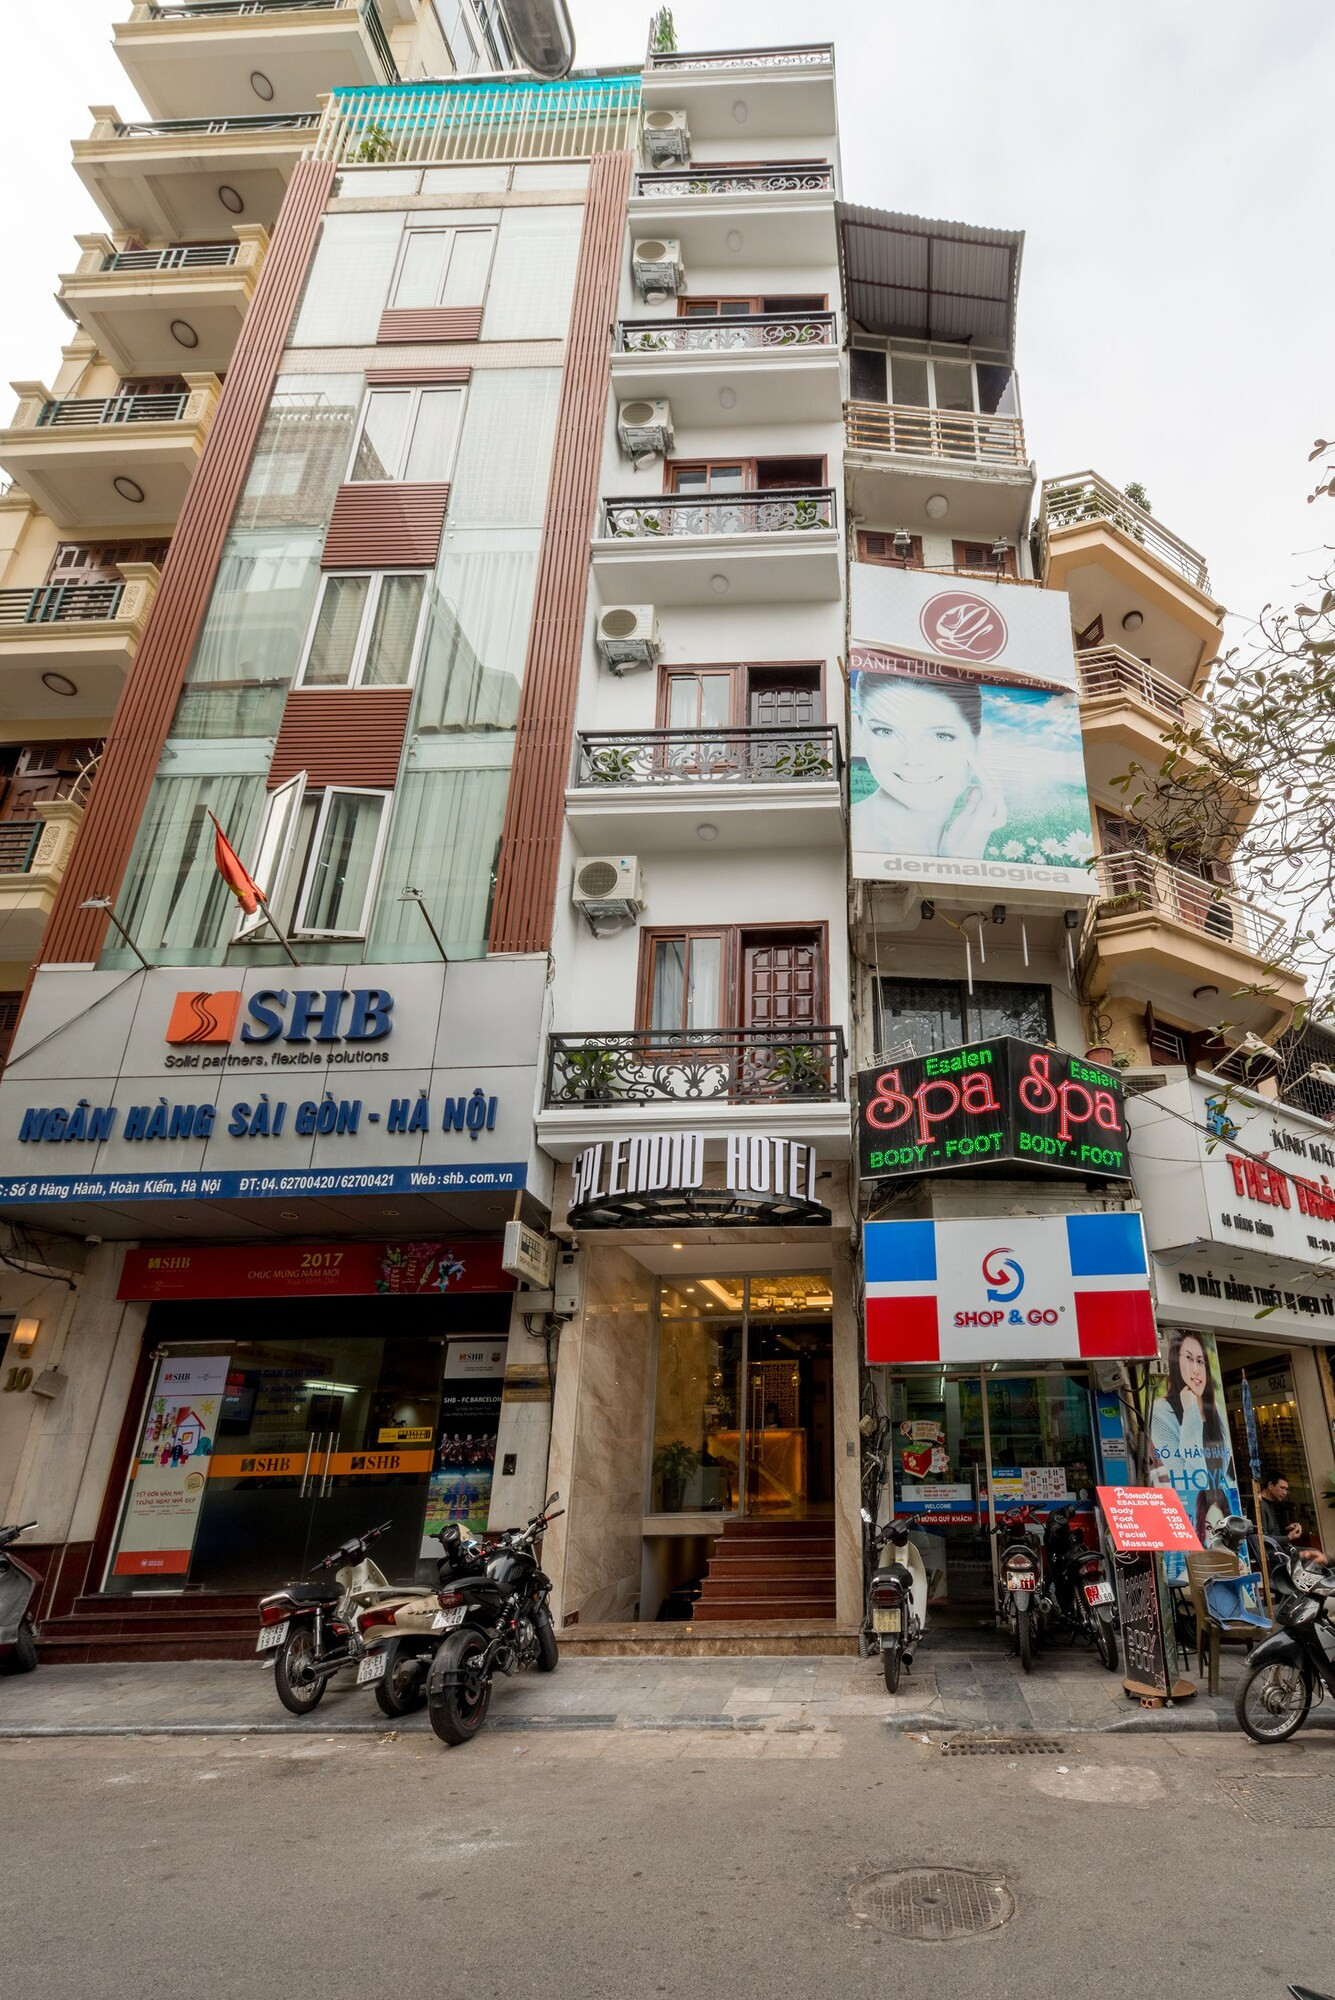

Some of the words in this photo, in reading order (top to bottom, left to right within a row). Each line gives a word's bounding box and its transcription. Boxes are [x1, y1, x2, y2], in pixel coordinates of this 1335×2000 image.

[883, 857, 1070, 884] dermalogica
[241, 989, 394, 1043] SHB
[164, 1050, 200, 1068] Solid
[201, 1052, 268, 1069] partners,
[271, 1051, 322, 1066] flexible
[326, 1049, 390, 1064] solutions
[925, 1049, 993, 1076] Esalen
[866, 1069, 1000, 1145] Spa
[1019, 1054, 1122, 1141] Spa
[17, 1098, 118, 1143] NGÂN
[122, 1097, 218, 1141] HÀNG
[228, 1093, 288, 1137] SÀI
[295, 1091, 362, 1135] GÒN
[387, 1089, 429, 1132] HÀ
[442, 1087, 499, 1139] NỘI
[870, 1145, 926, 1168] BODY
[946, 1133, 1003, 1158] FOOT
[1019, 1132, 1067, 1157] BODY
[1081, 1145, 1122, 1168] FOOT
[568, 1131, 704, 1208] SPLENDID
[727, 1133, 822, 1204] HOTEL
[9, 1182, 28, 1196] Số
[29, 1183, 37, 1196] 8
[39, 1183, 69, 1198] Hàng
[73, 1181, 107, 1196] Hành,
[109, 1181, 139, 1194] Hoàn
[181, 1179, 197, 1193] Hà
[201, 1179, 222, 1194] Nội
[161, 1257, 191, 1270] SHB
[300, 1253, 344, 1268] 2017
[953, 1309, 1005, 1328] SHOP
[1008, 1309, 1025, 1325] &
[3, 1366, 34, 1392] 10
[172, 1373, 191, 1381] SHB
[1153, 1444, 1170, 1459] SỐ
[1174, 1448, 1181, 1459] 4
[1184, 1445, 1211, 1458] HÀNG
[256, 1458, 290, 1471] SHB
[366, 1456, 401, 1469] SHB
[1169, 1468, 1230, 1491] HOYA
[454, 1495, 468, 1508] 12
[1113, 1487, 1164, 1500] Promotion
[1110, 1507, 1134, 1515] Body
[1121, 1540, 1164, 1548] Massage
[1172, 1531, 1193, 1539] 15%
[1126, 1626, 1157, 1653] BODY
[1128, 1647, 1155, 1674] FOOT
